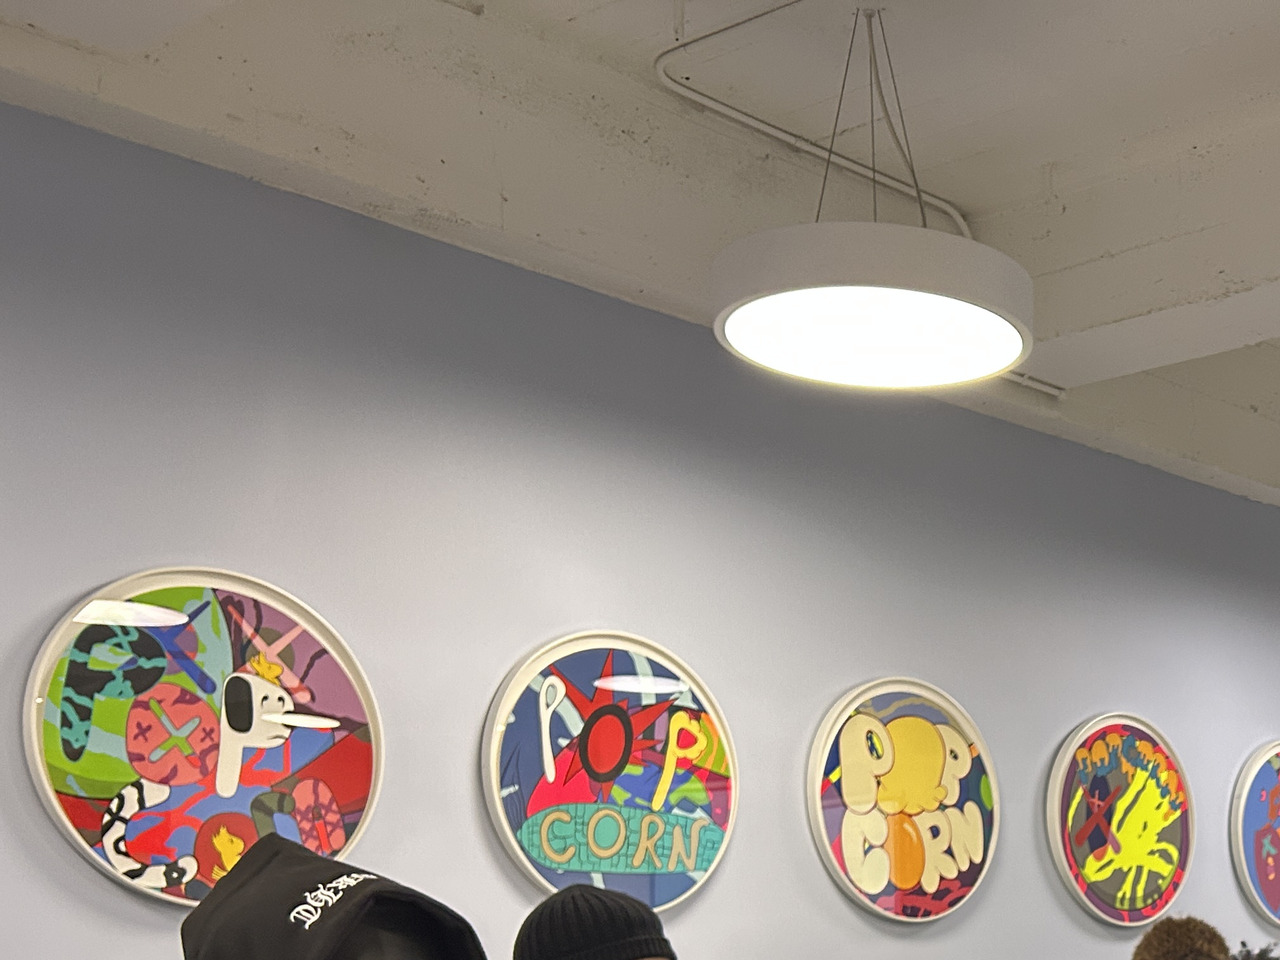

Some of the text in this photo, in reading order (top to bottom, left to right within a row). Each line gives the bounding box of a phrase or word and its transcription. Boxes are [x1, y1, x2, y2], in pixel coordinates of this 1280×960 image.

[538, 675, 708, 811] POP
[839, 714, 972, 815] POP
[540, 809, 710, 871] CORN
[841, 800, 984, 895] CORN
